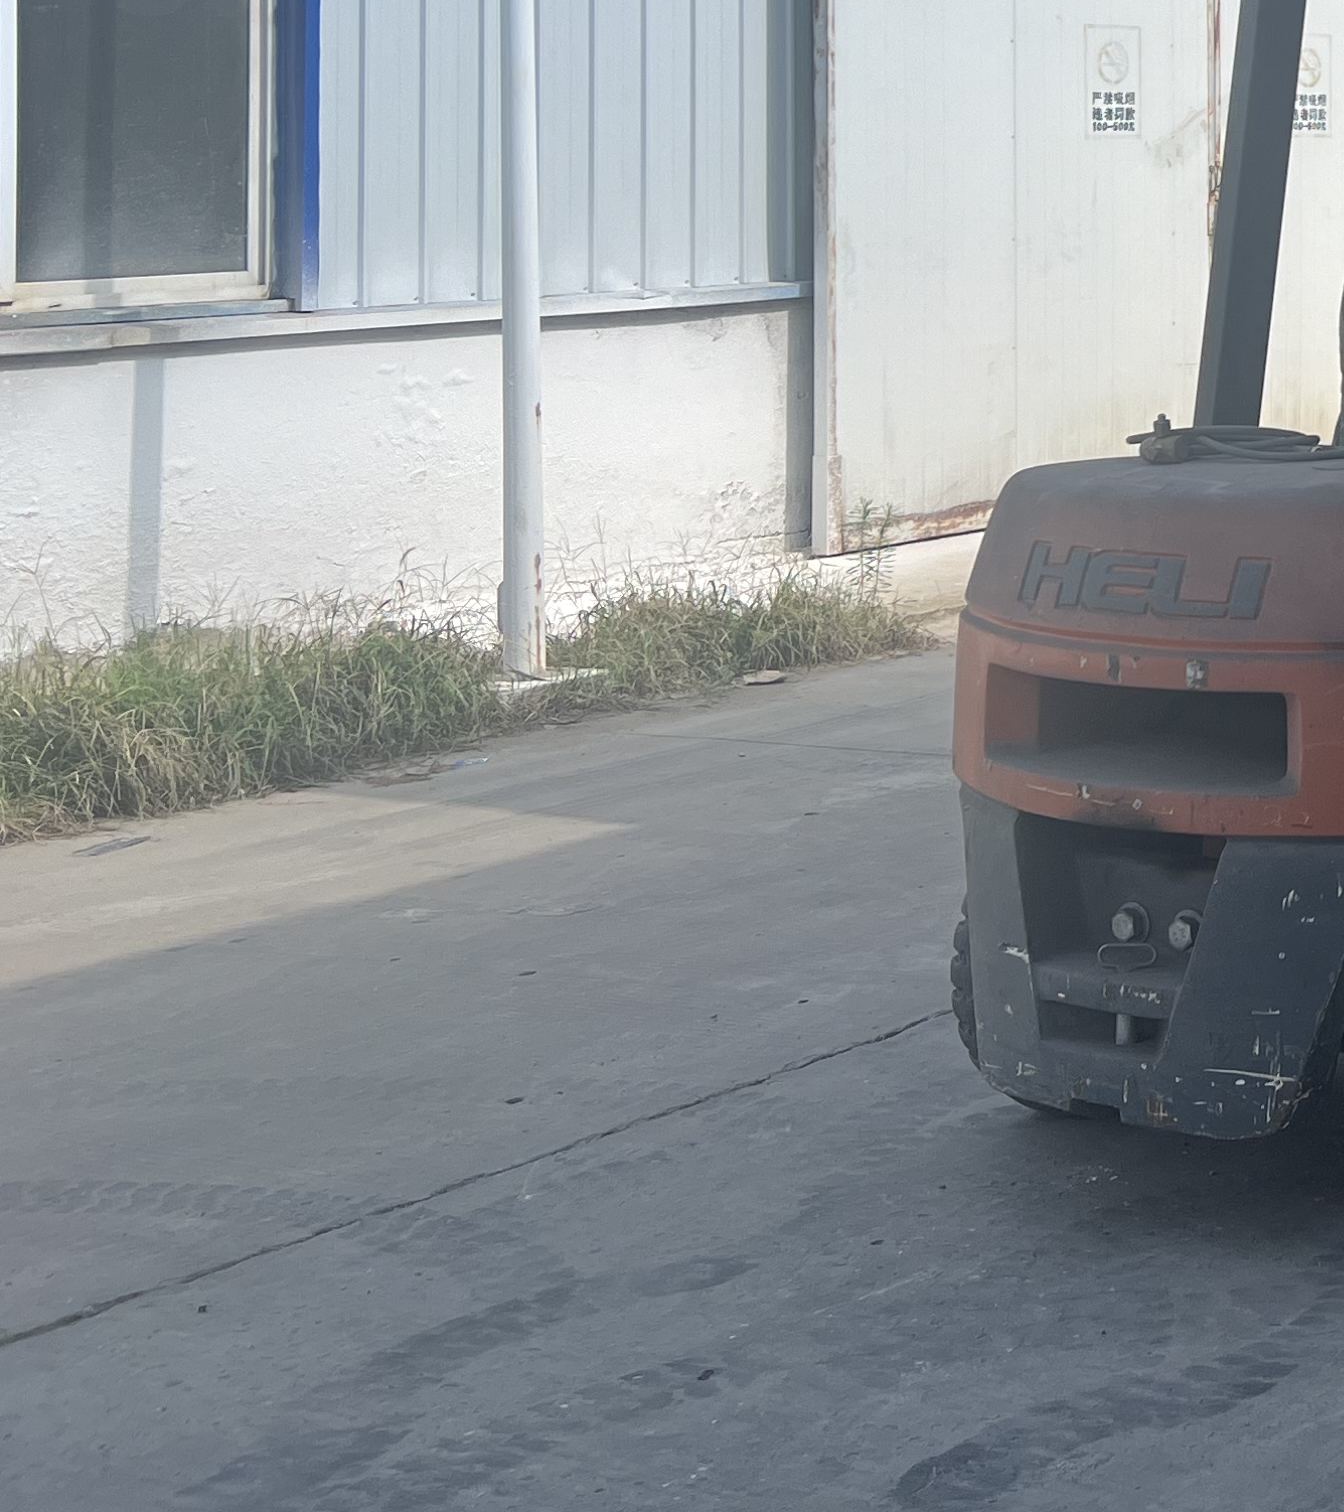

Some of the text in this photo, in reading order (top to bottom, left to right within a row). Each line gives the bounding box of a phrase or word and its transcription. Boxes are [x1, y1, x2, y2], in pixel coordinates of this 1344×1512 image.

[1092, 91, 1135, 105] 严禁吸烟
[1092, 107, 1135, 120] 违者罚款
[1017, 540, 1275, 620] HELI
